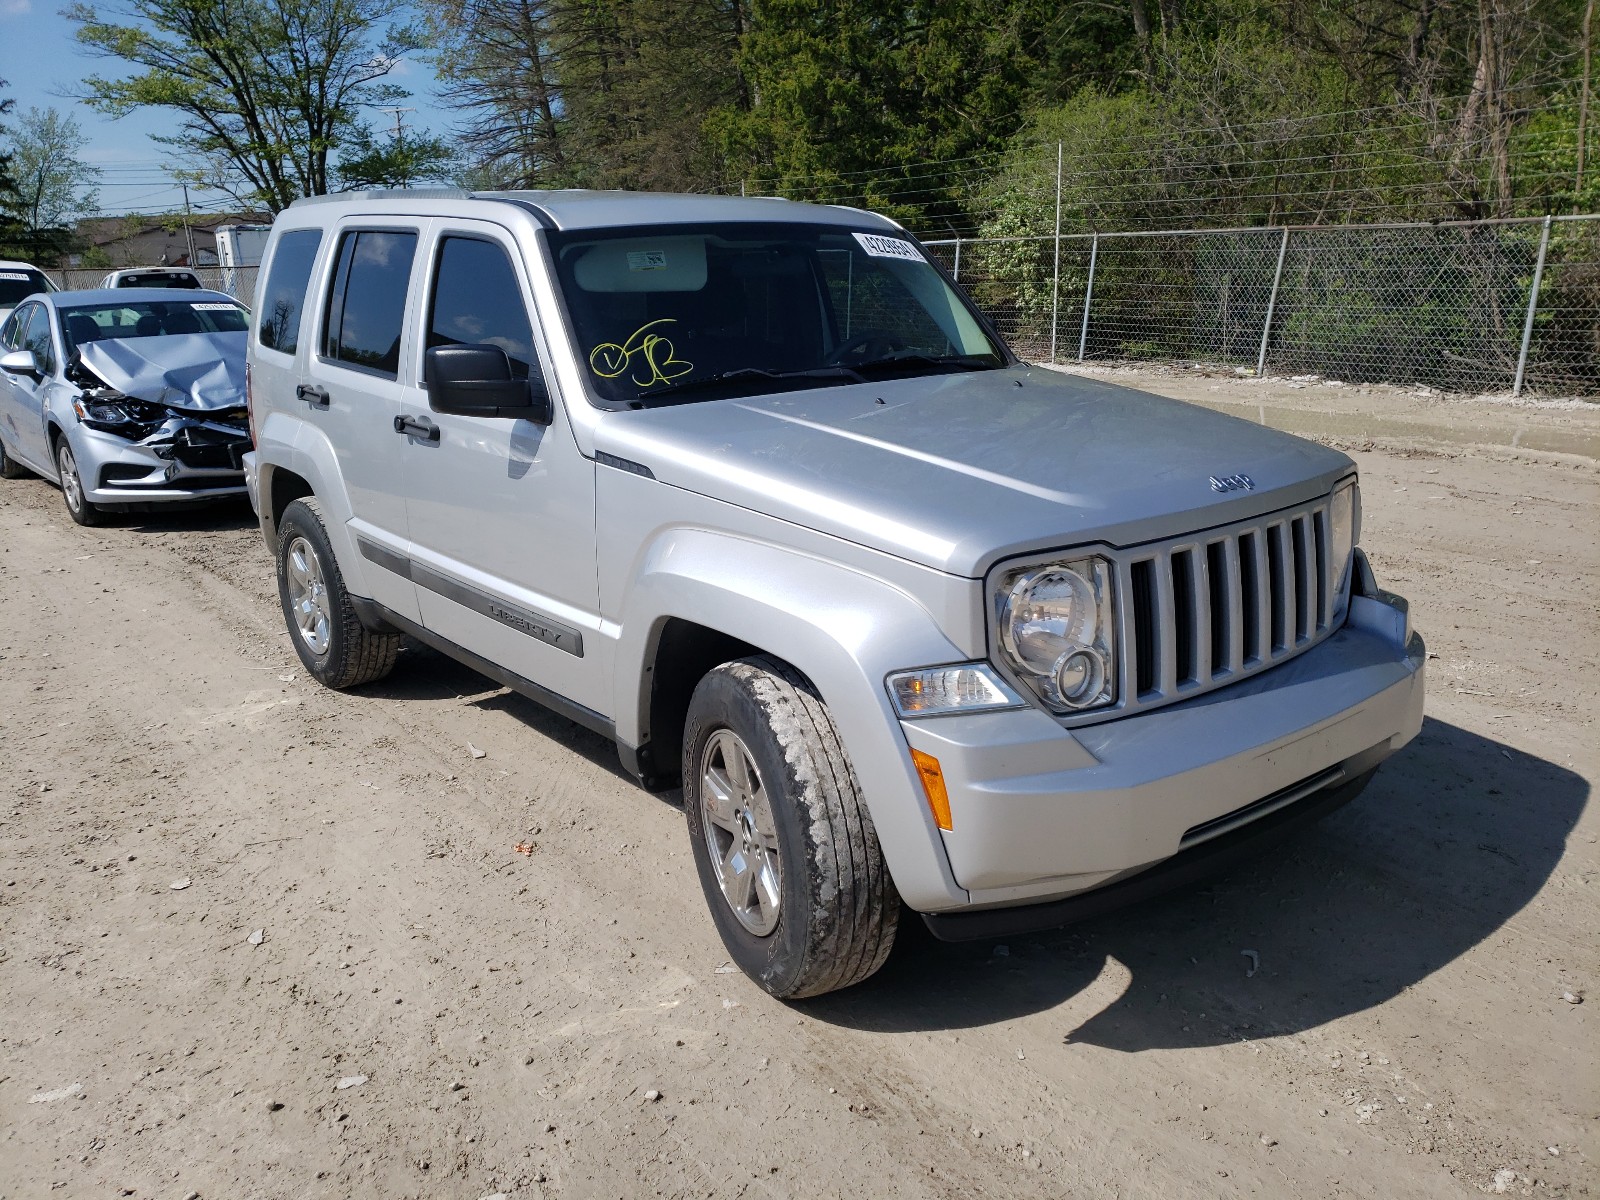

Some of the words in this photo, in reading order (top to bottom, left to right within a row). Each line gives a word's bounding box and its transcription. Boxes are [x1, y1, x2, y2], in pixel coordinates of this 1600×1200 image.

[864, 236, 917, 259] 42299541
[1209, 474, 1255, 493] Jeep
[486, 600, 561, 642] LIBERTY
